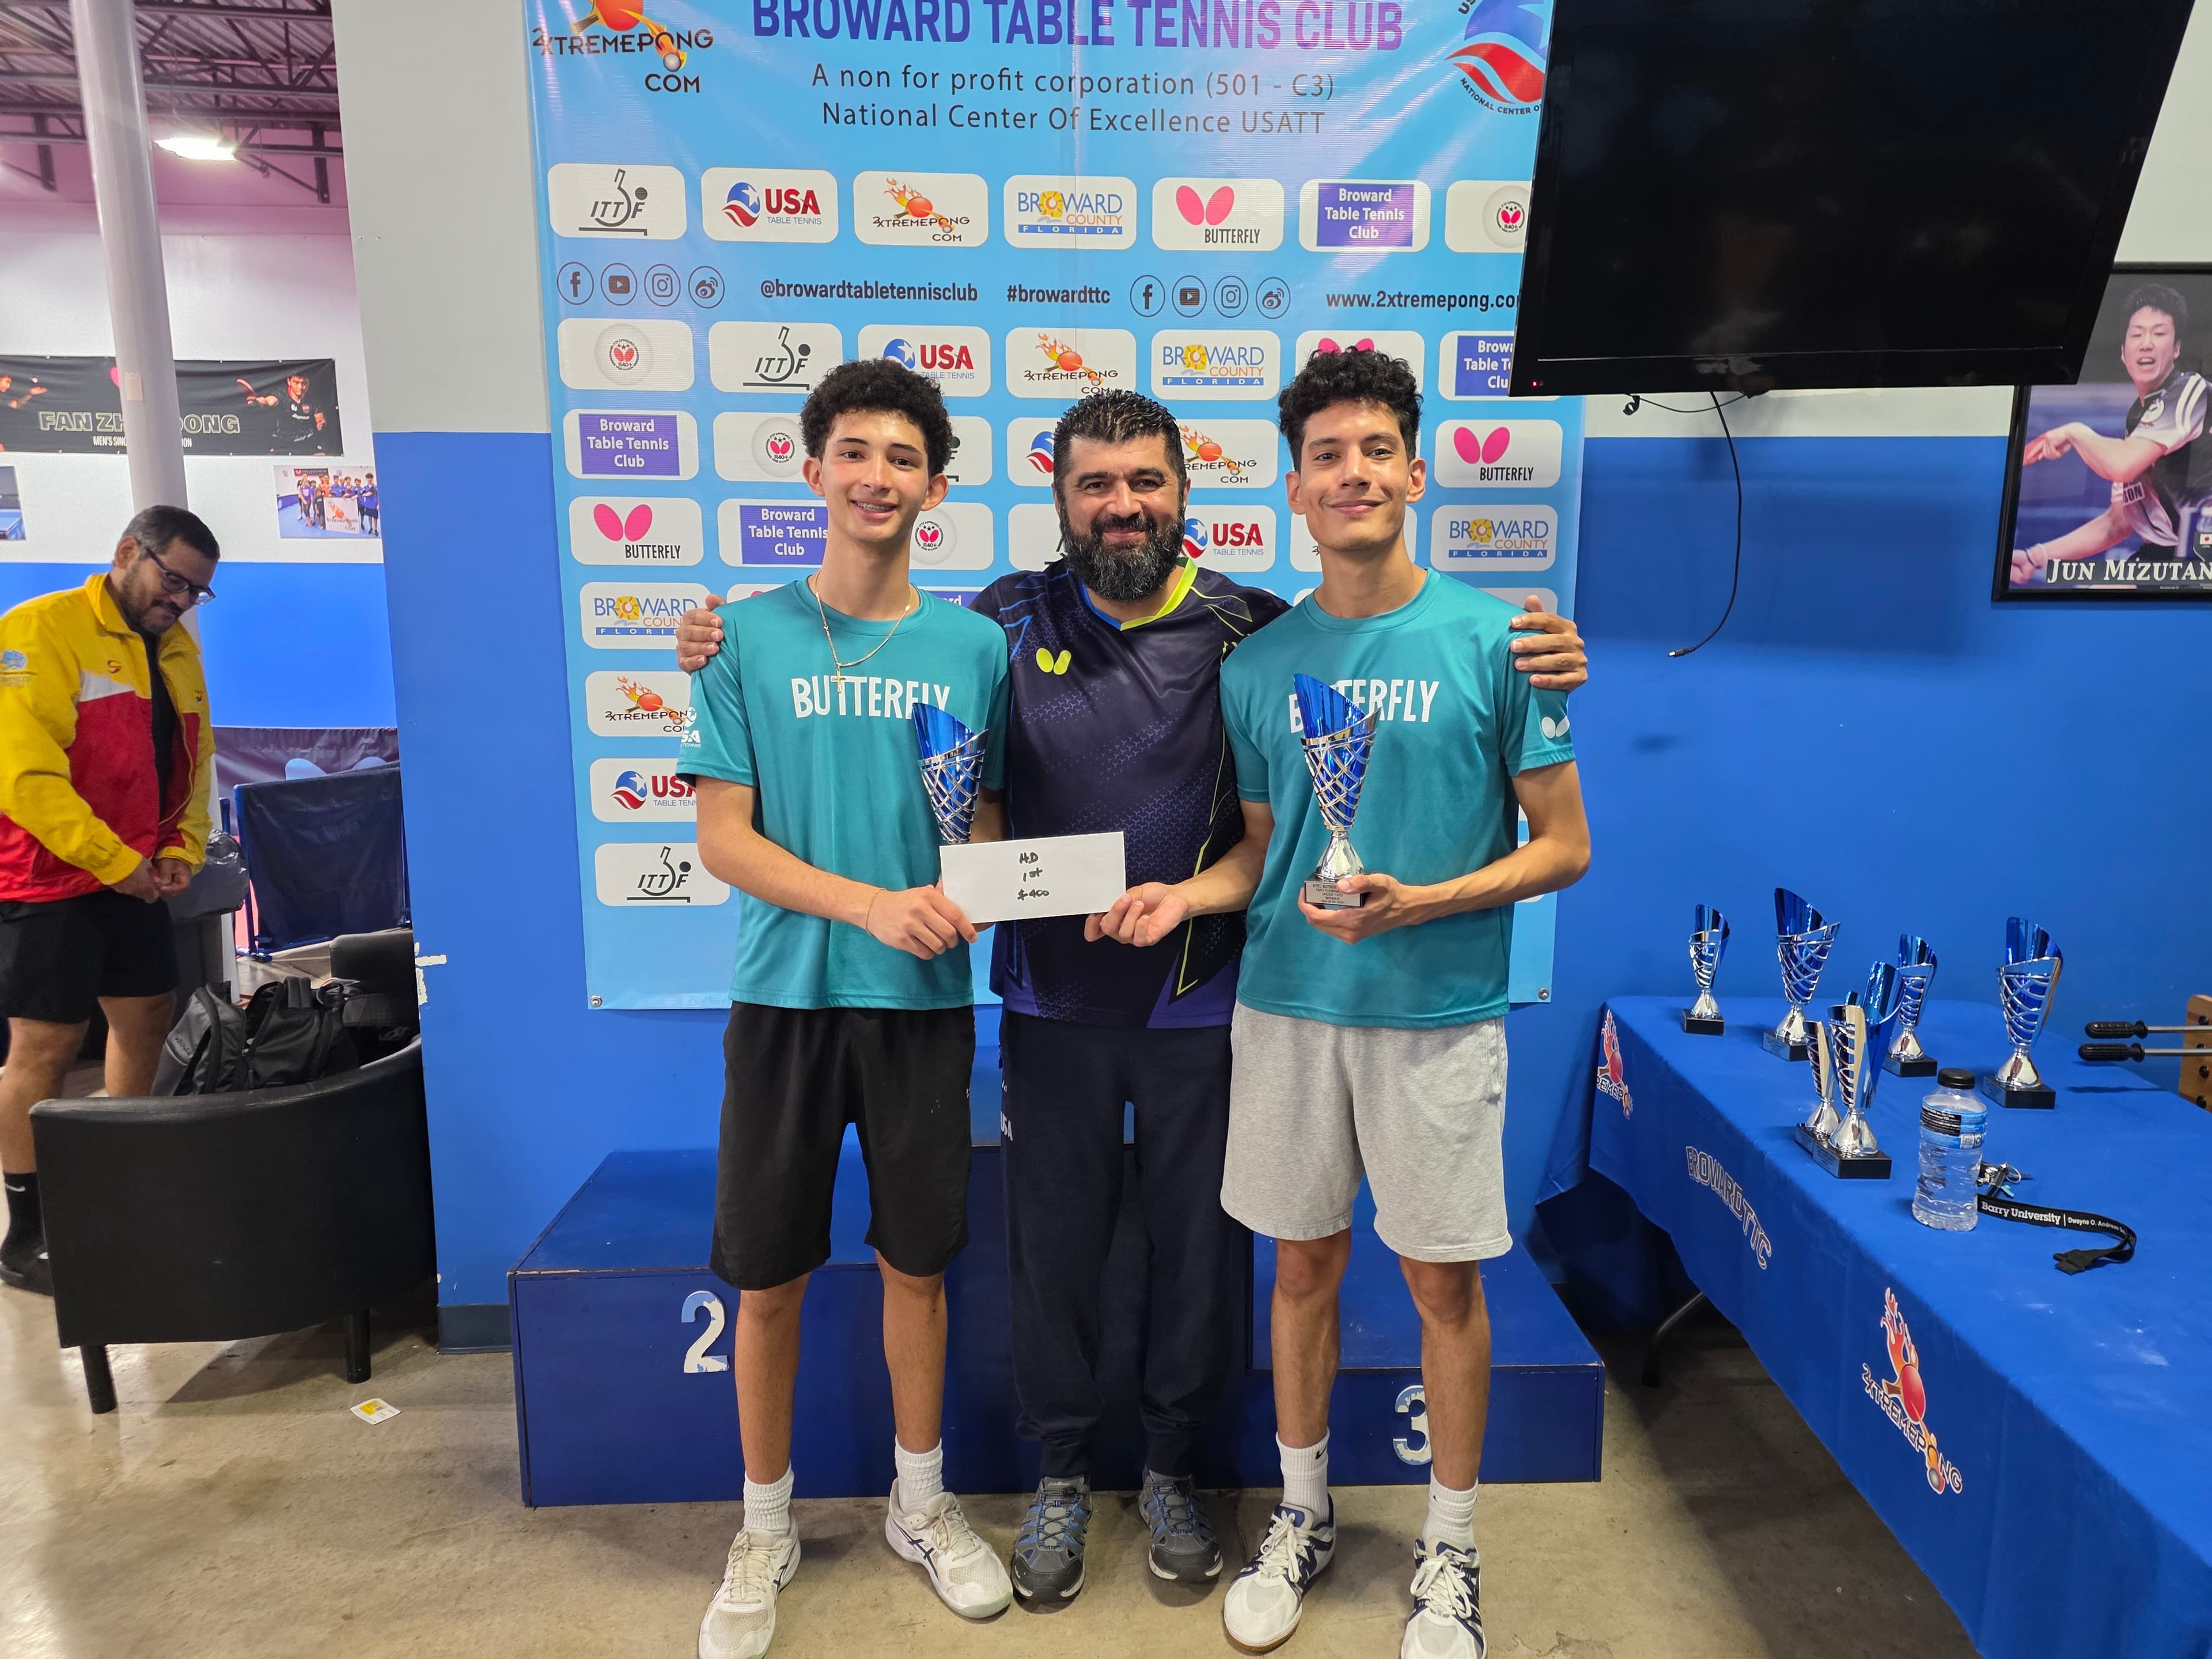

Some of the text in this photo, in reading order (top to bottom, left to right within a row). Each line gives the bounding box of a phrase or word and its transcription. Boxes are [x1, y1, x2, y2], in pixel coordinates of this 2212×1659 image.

[752, 0, 1403, 51] BROWARD TABLE TENNIS CLUB
[645, 73, 700, 93] COM
[812, 63, 829, 86] A
[840, 69, 890, 87] non
[901, 64, 940, 89] for
[950, 67, 1023, 95] profit
[1034, 71, 1194, 99] corporation
[1207, 72, 1259, 99] (501
[1291, 73, 1334, 100] C3)
[1460, 77, 1494, 111] NATIONAL
[1498, 106, 1531, 115] CENTER
[823, 102, 1326, 134] National Center Of Excellence USATT
[763, 188, 821, 215] USA
[1017, 191, 1122, 215] BROWARD
[1339, 188, 1392, 203] Broward
[766, 216, 821, 225] TABLE TENNIS
[1066, 214, 1122, 225] COUNTY
[1324, 207, 1405, 221] Table Tennis
[932, 233, 962, 242] COM
[1022, 226, 1118, 234] FLORIDA
[1205, 229, 1260, 244] BUTTERFLY
[1349, 225, 1379, 239] Club
[760, 279, 978, 301] @browardtabletennisclub
[1006, 283, 1111, 304] #browardttc
[1326, 290, 1521, 312] www.2xtremepong.co
[1478, 340, 1514, 354] Brow
[920, 344, 974, 370] USA
[1162, 346, 1265, 366] BROWARD
[754, 357, 809, 374] ITTF
[1210, 367, 1264, 377] COUNTY
[1464, 358, 1498, 371] Table
[1487, 376, 1509, 389] Clu
[40, 411, 94, 433] FAN
[600, 418, 655, 433] Broward
[587, 436, 669, 450] Table Tennis
[614, 454, 645, 468] Club
[1184, 460, 1257, 471] REMEPONG
[1480, 467, 1534, 482] BUTTERFLY
[760, 507, 815, 522] Broward
[748, 525, 828, 539] Table Tennis
[1213, 522, 1263, 547] USA
[1449, 520, 1549, 539] BROWARD
[625, 545, 681, 559] BUTTERFLY
[774, 543, 805, 556] Club
[1494, 539, 1548, 550] COUNTY
[2047, 558, 2212, 584] JUN MIZUTAN
[594, 597, 698, 618] BROWARD
[643, 617, 682, 627] COUN
[1289, 679, 1440, 733] BTERFLY
[605, 710, 688, 722] 2XTREMEPON
[681, 730, 701, 743] SA
[637, 874, 690, 888] ITTF
[1686, 1146, 1743, 1221] BROWARD
[1982, 1201, 2010, 1217] Barry
[2011, 1207, 2061, 1225] University
[2068, 1216, 2090, 1226] Dwayne
[681, 1290, 729, 1374] 2
[1393, 1385, 1433, 1465] 3
